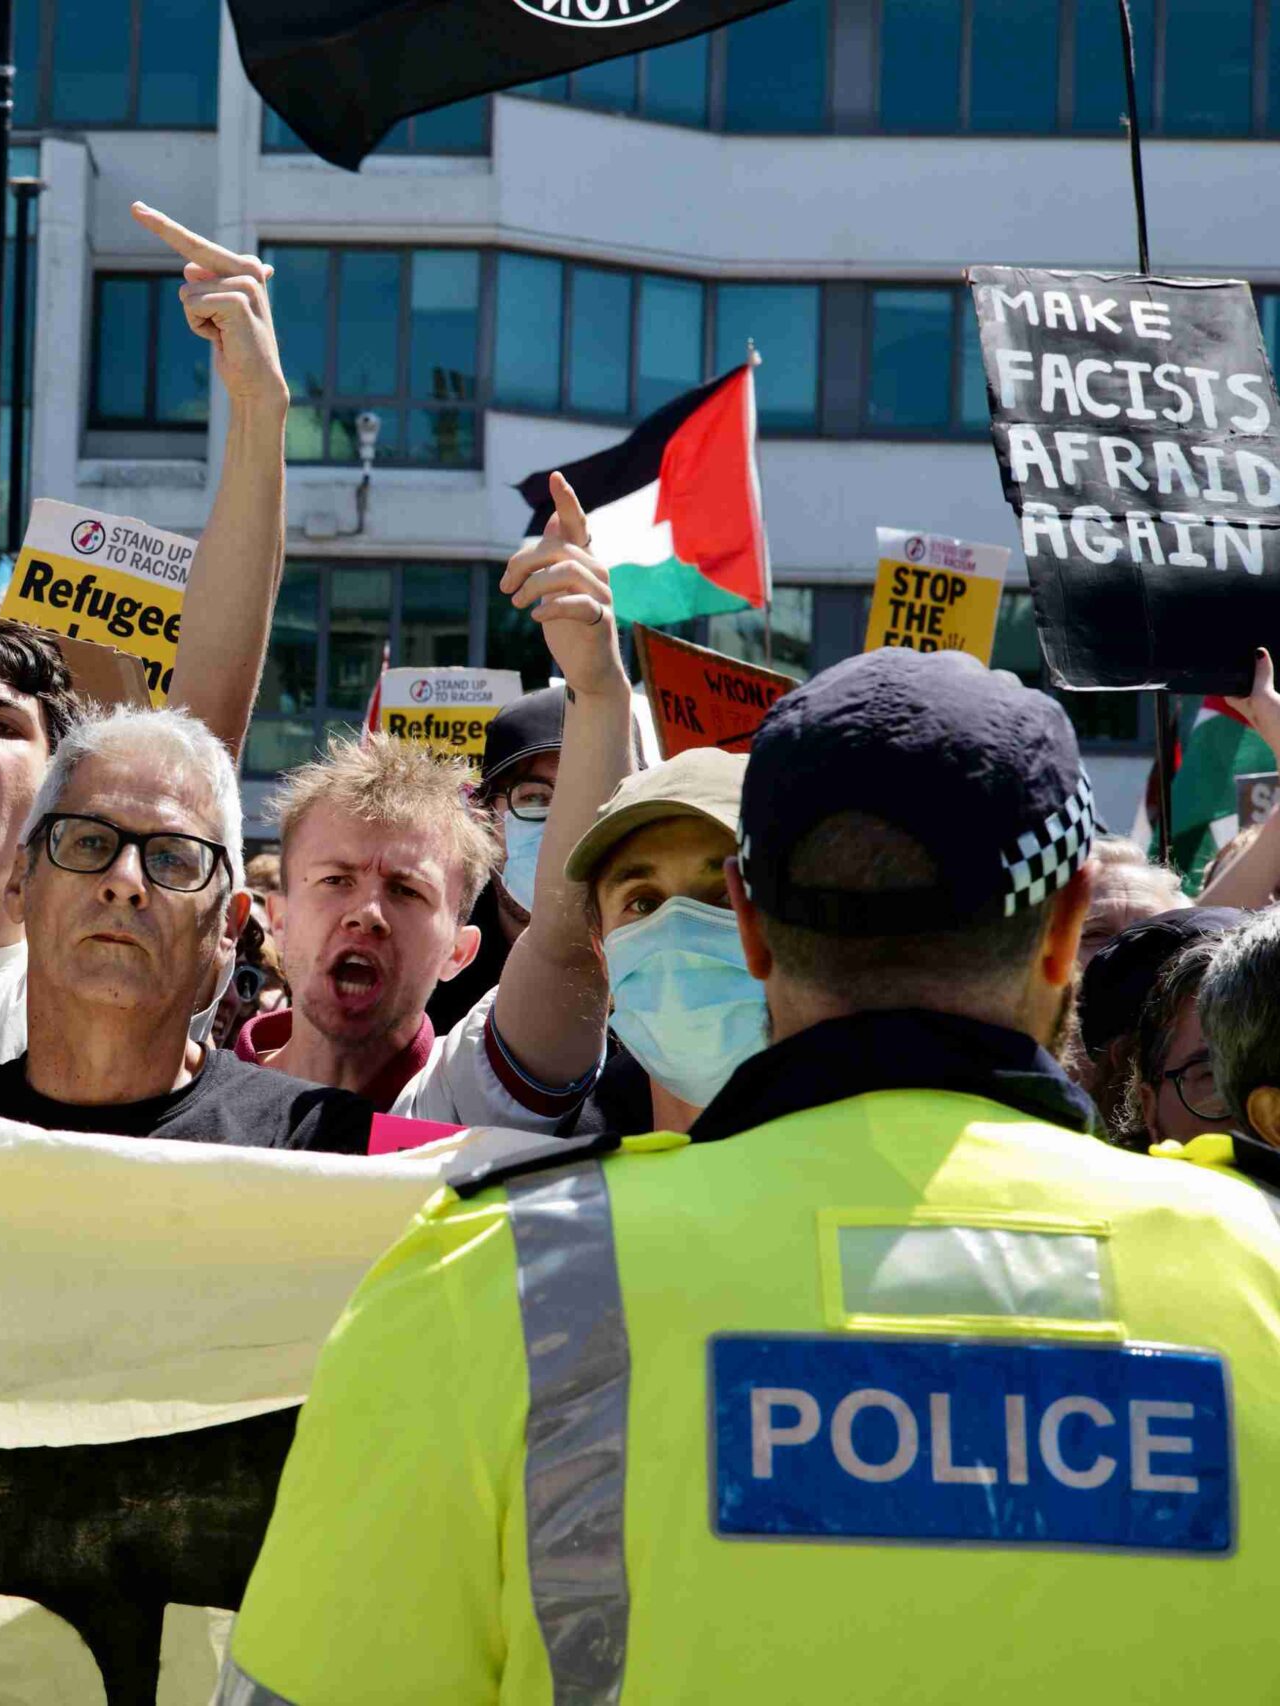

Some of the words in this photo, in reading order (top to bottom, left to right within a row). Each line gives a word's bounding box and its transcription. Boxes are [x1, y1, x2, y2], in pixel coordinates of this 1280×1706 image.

[988, 286, 1173, 341] MAKE
[995, 349, 1271, 434] FACISTS
[1007, 423, 1280, 508] AFRAID
[105, 544, 127, 564] TO
[109, 526, 165, 557] STAND
[167, 544, 193, 564] UP
[1021, 502, 1265, 576] AGAIN
[18, 559, 183, 644] Refugee
[891, 565, 967, 606] STOP
[888, 597, 945, 636] THE
[434, 679, 469, 691] STAND
[471, 680, 487, 691] UP
[434, 691, 449, 702] TO
[450, 691, 493, 702] RACISM
[389, 713, 493, 747] Refuge
[659, 687, 705, 735] FAR
[748, 1386, 1200, 1494] POLICE
